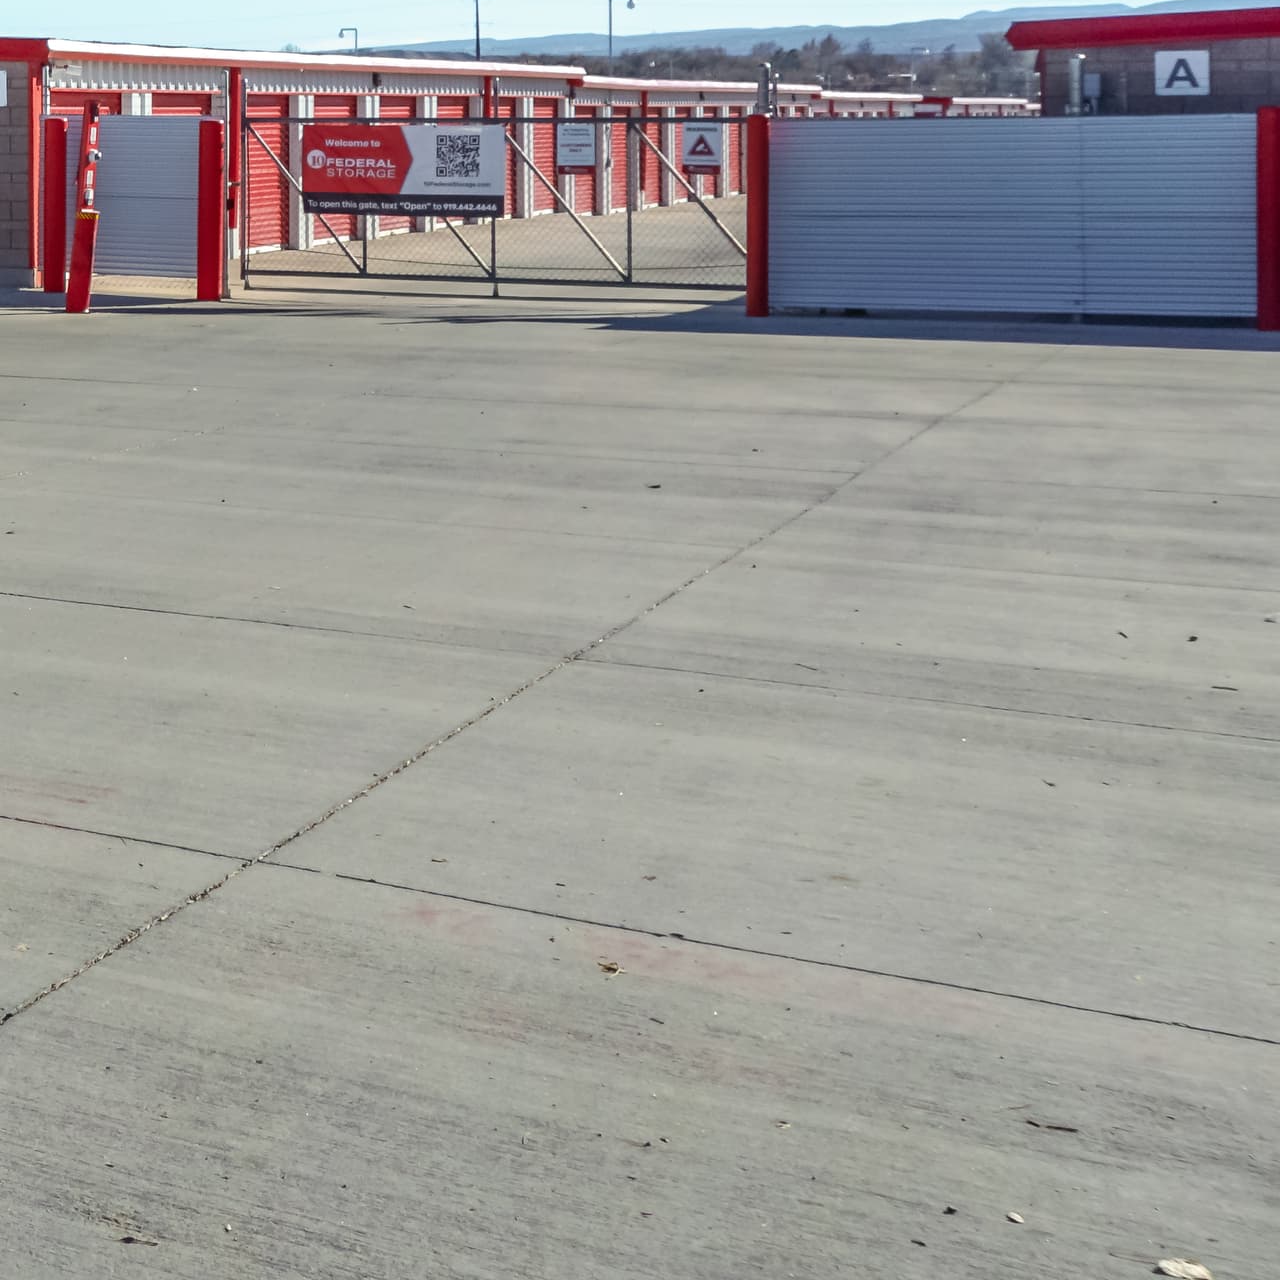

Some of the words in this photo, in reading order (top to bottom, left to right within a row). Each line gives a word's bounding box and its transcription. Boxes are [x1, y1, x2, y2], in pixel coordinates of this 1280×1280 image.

[1165, 58, 1199, 88] A
[325, 139, 369, 147] Welcome
[371, 139, 381, 147] to
[326, 158, 396, 168] FEDERAL
[326, 168, 396, 178] STORAGE
[341, 200, 357, 209] this
[433, 202, 441, 210] to
